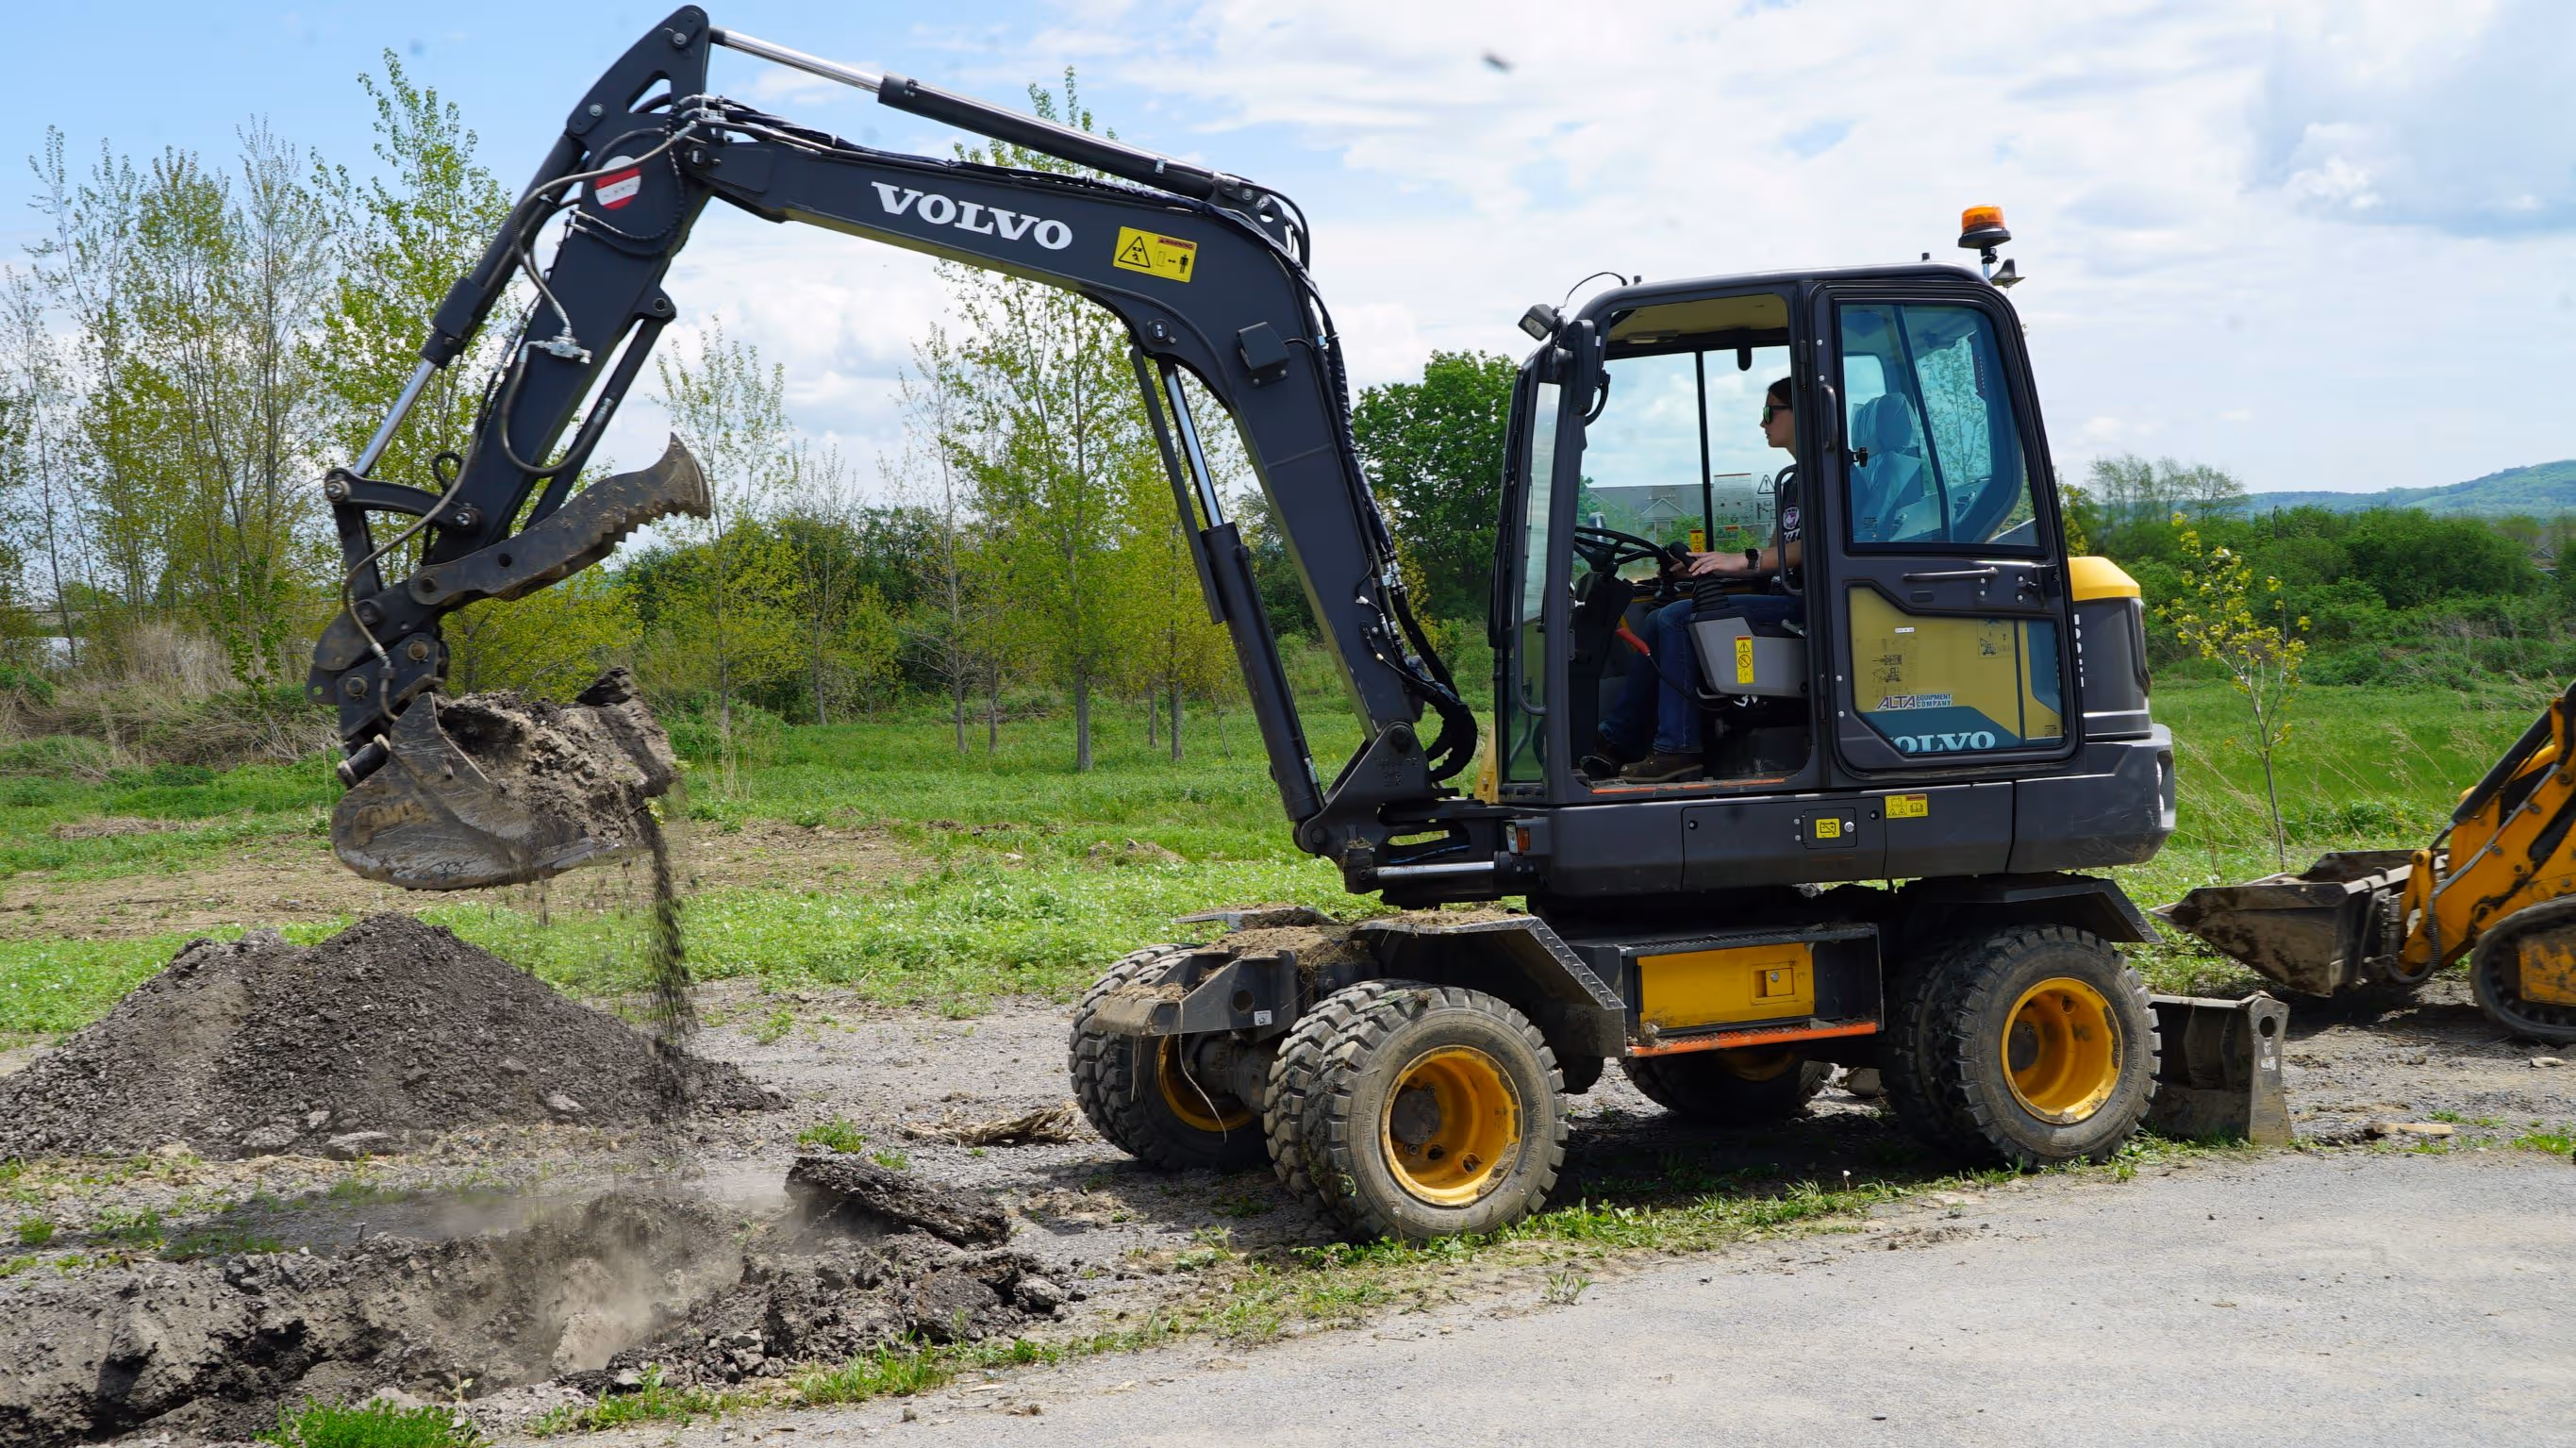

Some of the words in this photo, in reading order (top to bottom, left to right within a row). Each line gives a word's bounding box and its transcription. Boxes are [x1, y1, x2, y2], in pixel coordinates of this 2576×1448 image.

[871, 181, 1072, 250] VOLVO
[1876, 695, 1916, 709] ALTA
[1916, 693, 1952, 702] EQUIPMENT
[1917, 700, 1952, 708] COMPANY
[1889, 731, 1996, 754] OLVO
